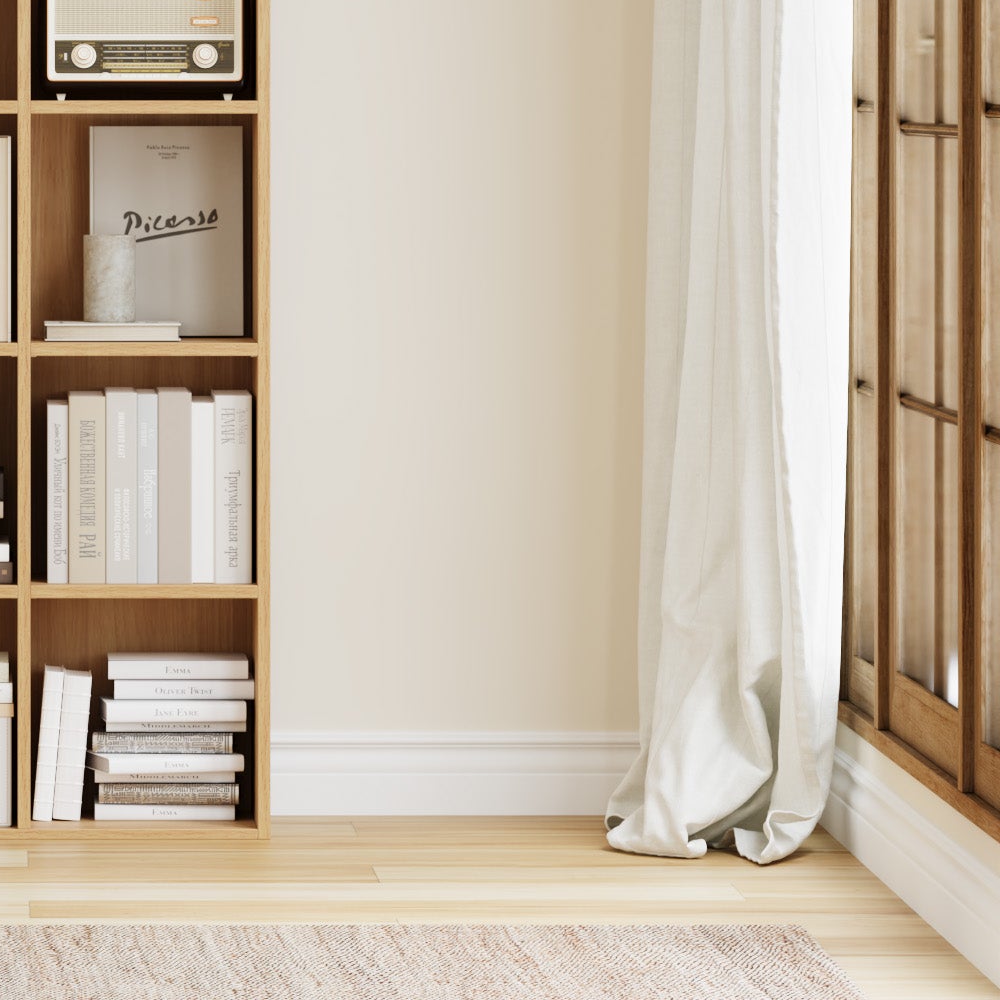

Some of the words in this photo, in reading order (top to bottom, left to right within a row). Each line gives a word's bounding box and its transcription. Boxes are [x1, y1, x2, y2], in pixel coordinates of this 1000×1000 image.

[123, 208, 219, 236] Picasso
[79, 420, 96, 485] БОЖЕСТВЕННАЯ
[78, 487, 96, 527] КОМЕДИЯ
[225, 469, 242, 542] Триумфальная
[53, 549, 67, 565] Боб
[78, 534, 101, 559] РАЙ
[225, 546, 239, 568] арка
